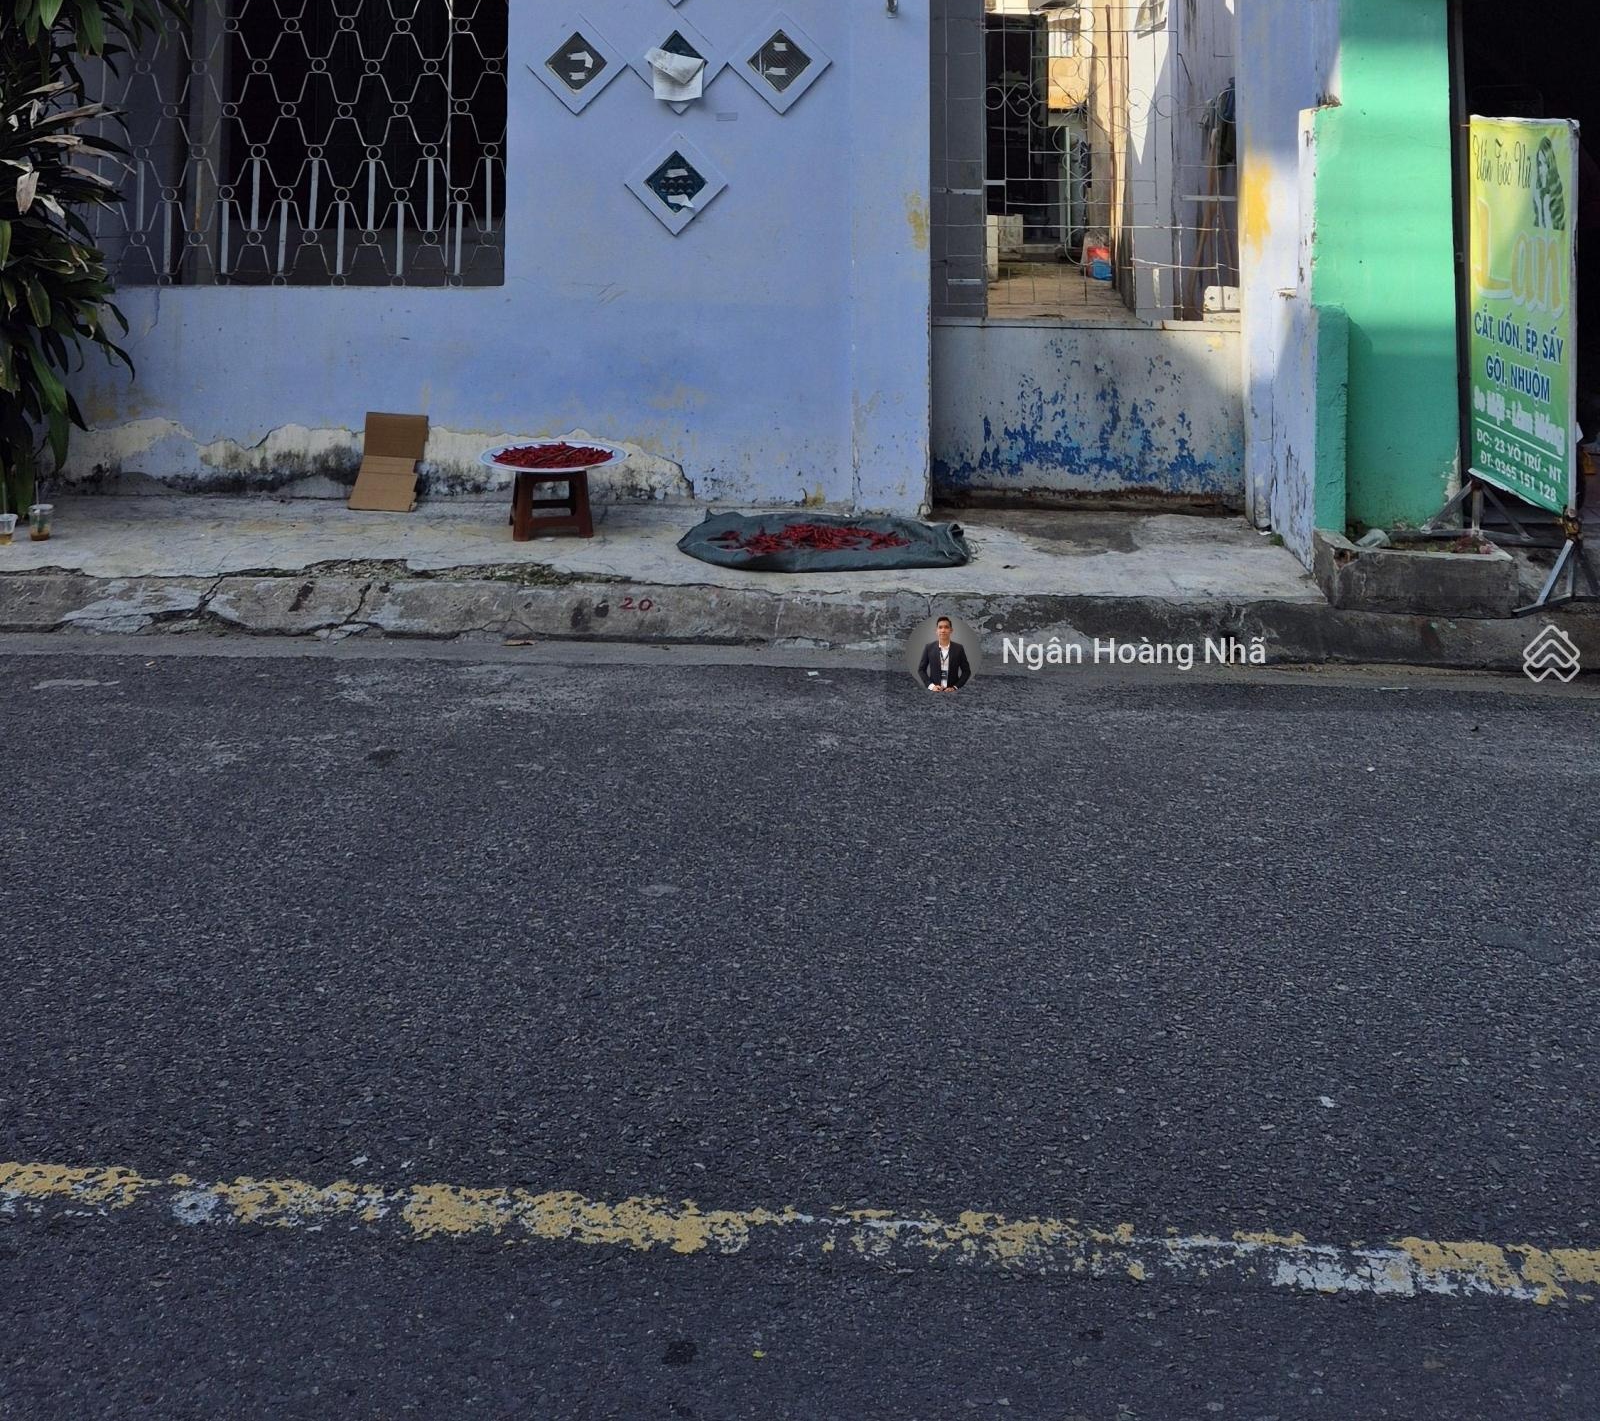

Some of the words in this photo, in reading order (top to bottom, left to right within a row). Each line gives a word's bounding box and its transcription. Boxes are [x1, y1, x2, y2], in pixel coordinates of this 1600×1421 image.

[1474, 196, 1564, 320] Lan
[1497, 312, 1523, 355] UỐN,
[1525, 322, 1540, 361] ÉP,
[1542, 326, 1564, 365] SẤY
[1510, 365, 1550, 407] NHUỘM
[1476, 428, 1493, 448] ĐC:
[1494, 437, 1506, 454] 23
[1507, 442, 1522, 462] VÕ
[1548, 464, 1562, 484] NT
[1519, 470, 1536, 491] 151
[619, 596, 654, 612] 20
